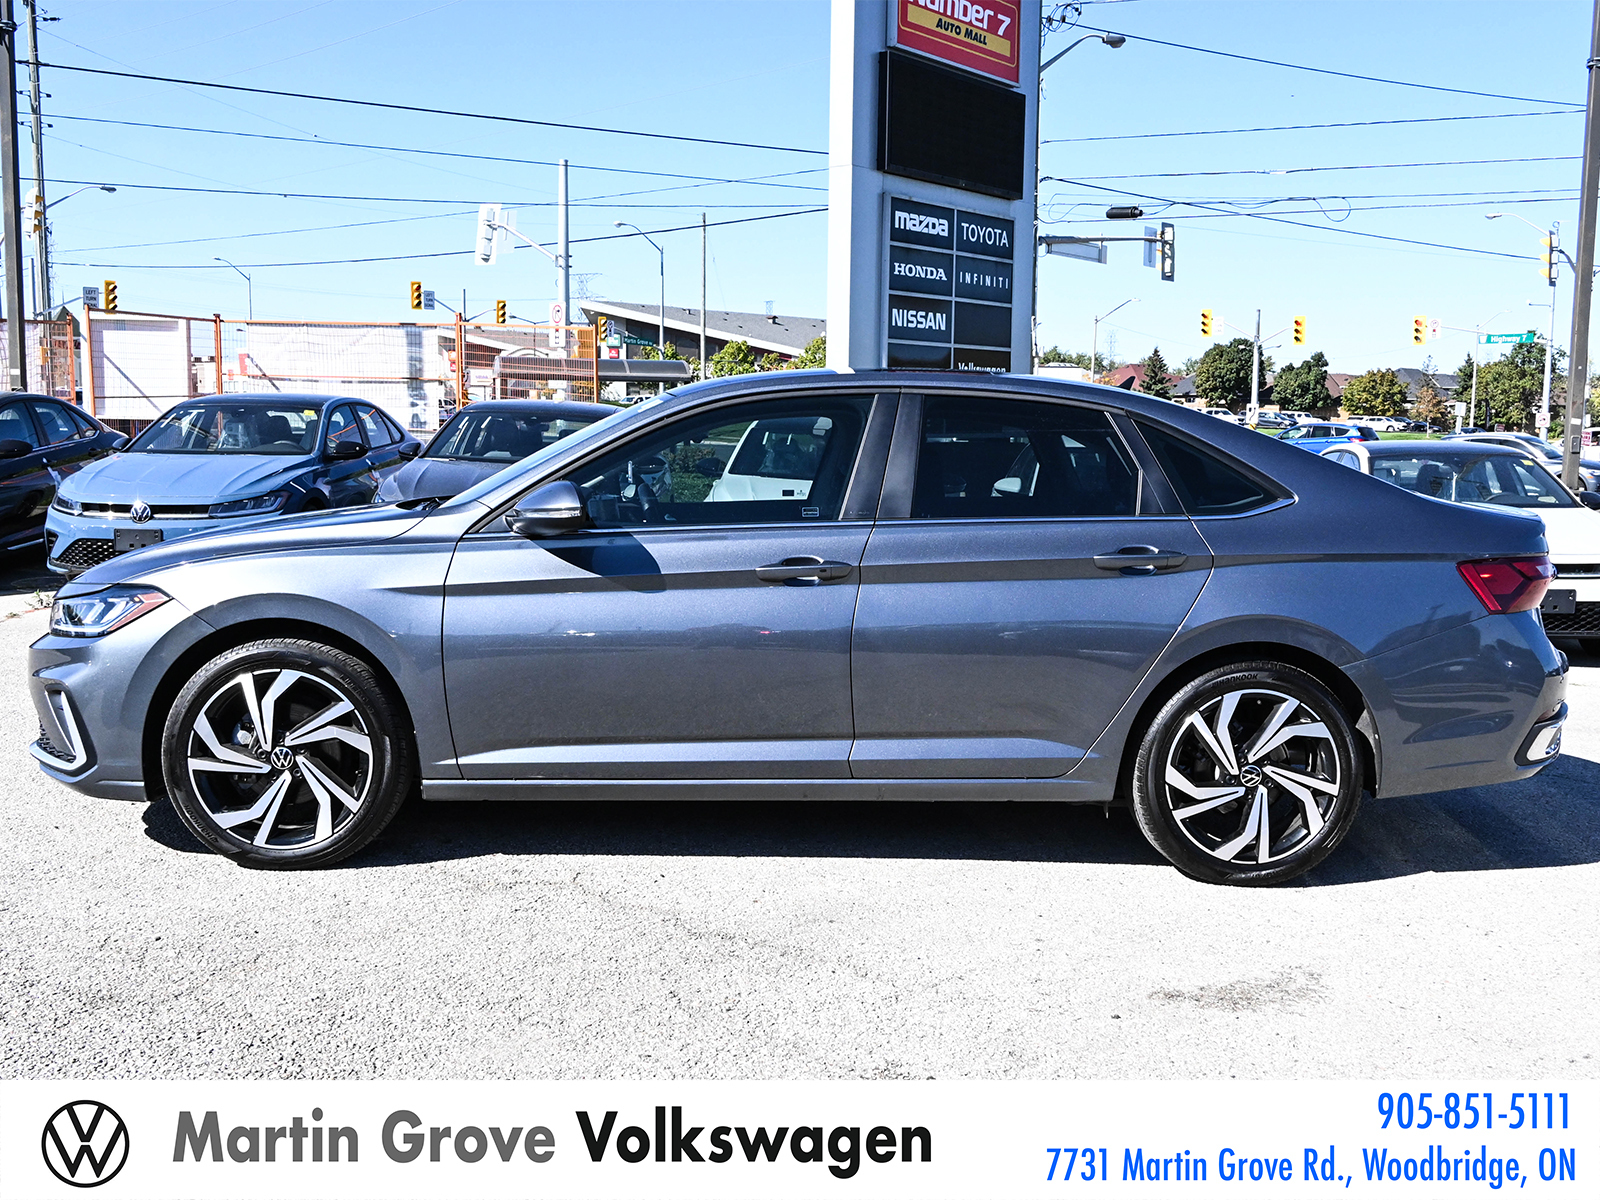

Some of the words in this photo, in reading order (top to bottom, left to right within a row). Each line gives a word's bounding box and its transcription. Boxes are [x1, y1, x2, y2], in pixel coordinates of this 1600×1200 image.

[909, 0, 994, 29] umber
[997, 14, 1011, 36] 7
[935, 18, 961, 36] AUTO
[964, 27, 987, 45] MALL
[961, 222, 1009, 248] TOYOTA
[893, 262, 948, 281] HONDA
[959, 271, 1009, 289] INFINITI
[892, 308, 946, 331] NISSAN
[1490, 335, 1520, 344] Highway
